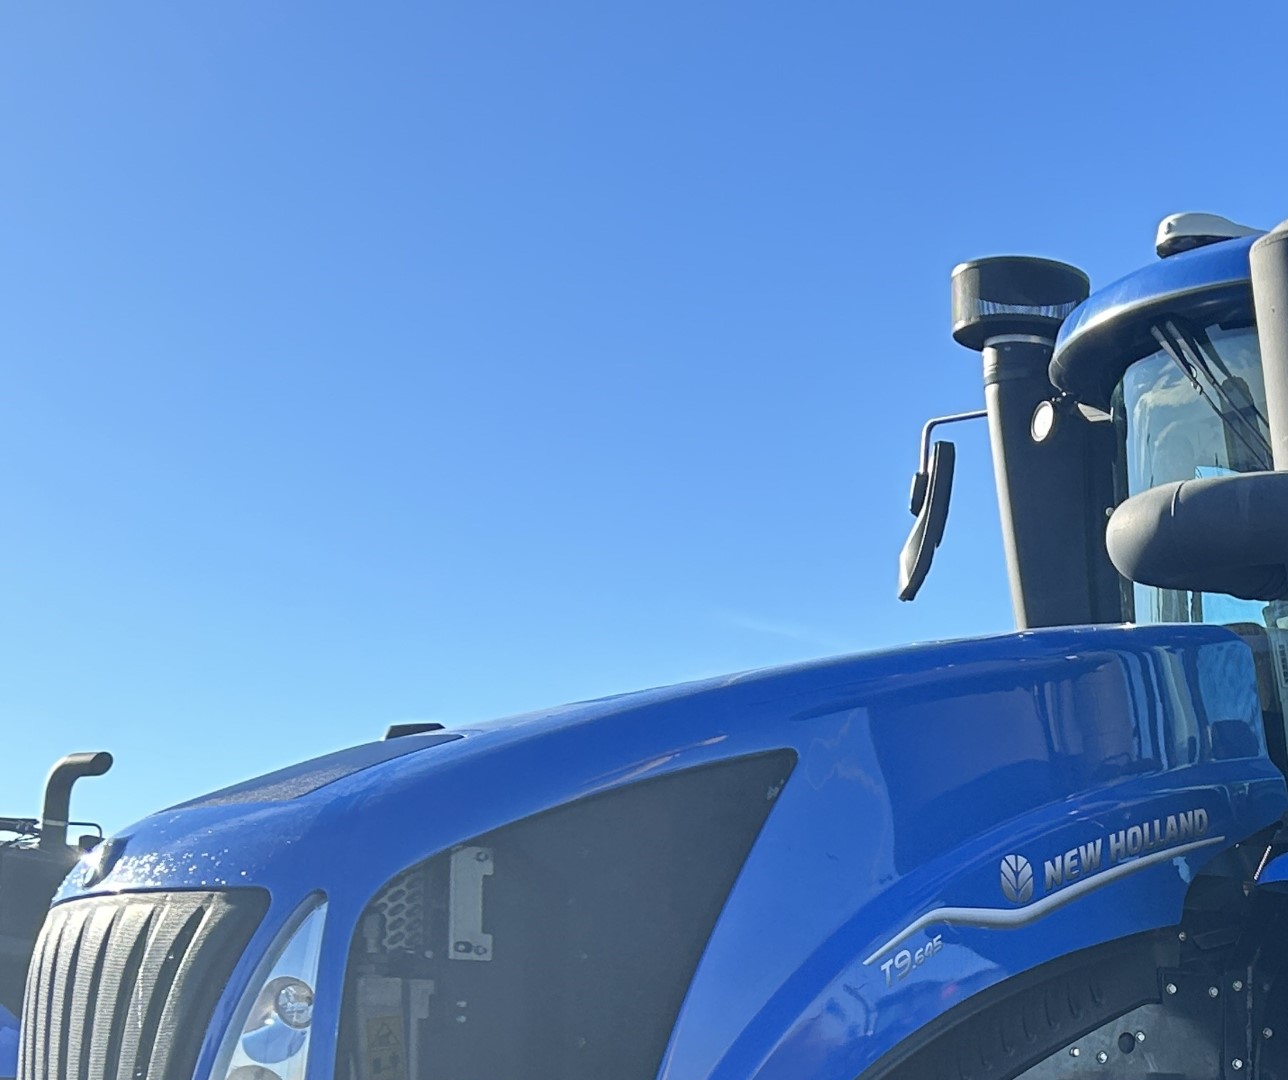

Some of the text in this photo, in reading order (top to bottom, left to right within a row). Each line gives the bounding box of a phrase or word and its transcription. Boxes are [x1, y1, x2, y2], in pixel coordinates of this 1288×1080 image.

[1044, 808, 1208, 891] NEW HOLLAND
[880, 934, 943, 988] T9.645
